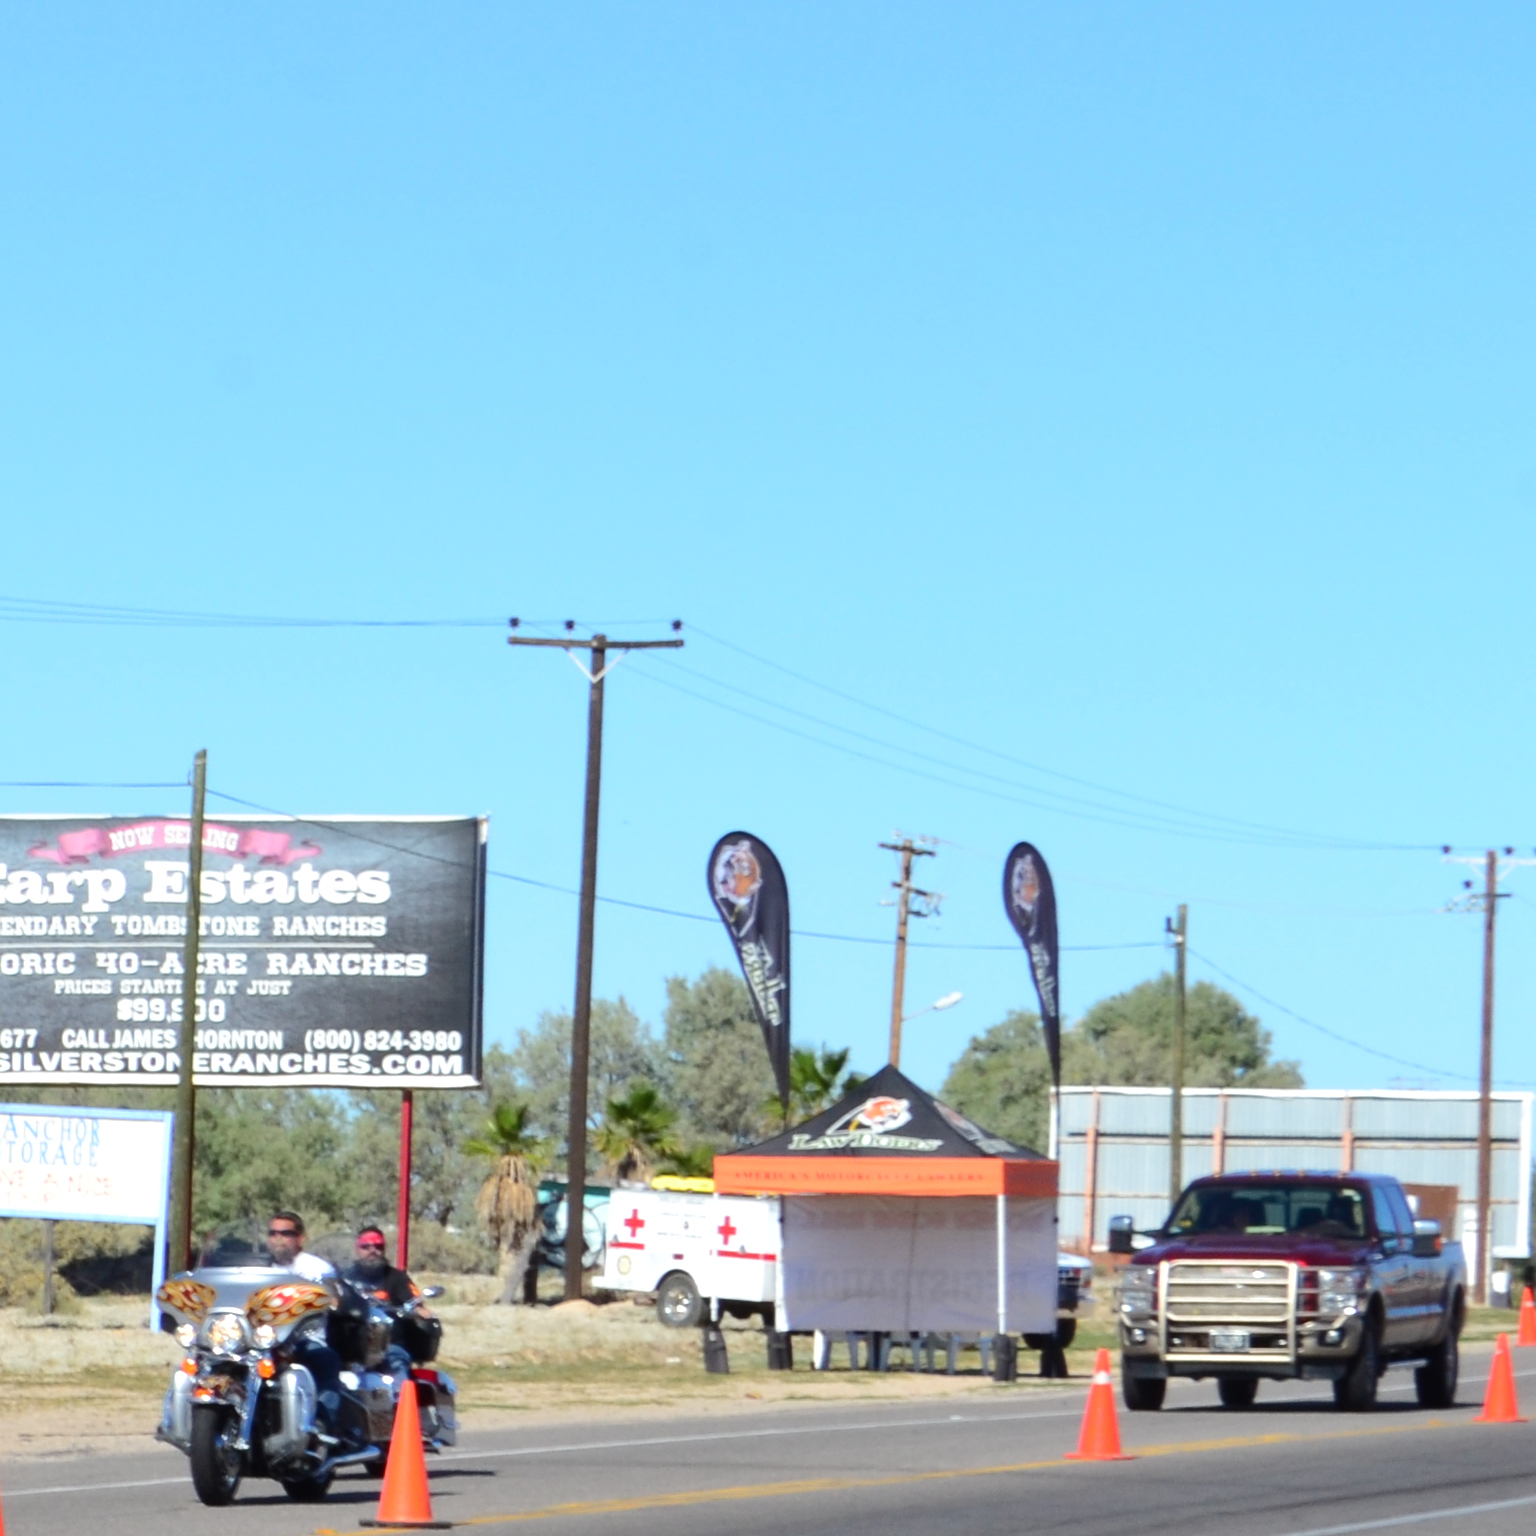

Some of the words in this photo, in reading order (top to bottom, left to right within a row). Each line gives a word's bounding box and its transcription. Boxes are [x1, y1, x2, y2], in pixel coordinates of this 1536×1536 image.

[109, 828, 154, 850] NOW
[143, 861, 391, 904] Estates
[273, 916, 387, 937] RANCHES
[266, 952, 428, 976] RANCHES
[54, 979, 112, 995] PRICES
[119, 979, 206, 995] STARTIG
[214, 980, 238, 995] AT
[246, 980, 292, 995] JUST
[61, 1029, 111, 1049] CALL
[112, 1029, 177, 1049] JAMES
[193, 1030, 284, 1050] HORNTON
[304, 1029, 360, 1053] (800)
[363, 1030, 463, 1051] 824-3980
[3, 1114, 100, 1146] ANCHOR
